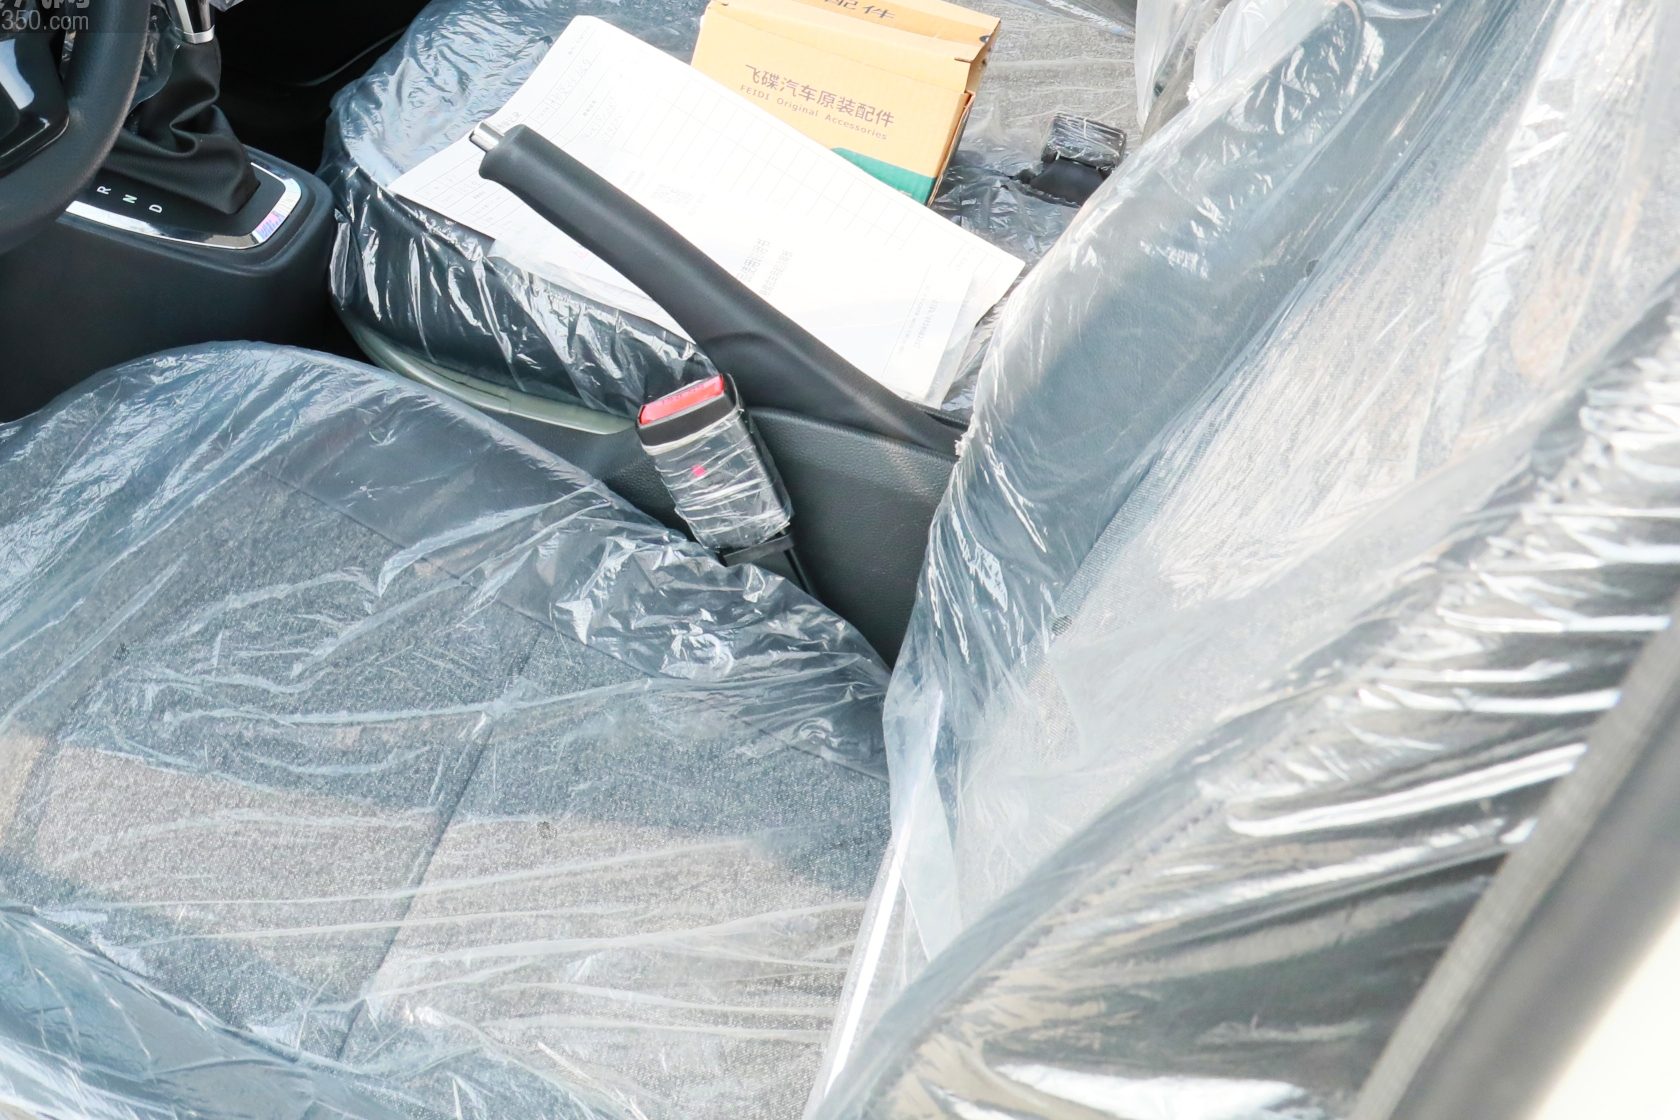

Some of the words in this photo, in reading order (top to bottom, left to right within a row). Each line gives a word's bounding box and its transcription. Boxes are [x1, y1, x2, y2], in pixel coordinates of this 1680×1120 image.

[745, 64, 894, 128] 飞碟汽车原装配件
[740, 84, 770, 101] FEIDI
[776, 97, 818, 118] Original
[825, 114, 888, 140] Accessories
[96, 185, 112, 195] R
[123, 194, 138, 204] N
[149, 204, 163, 214] D
